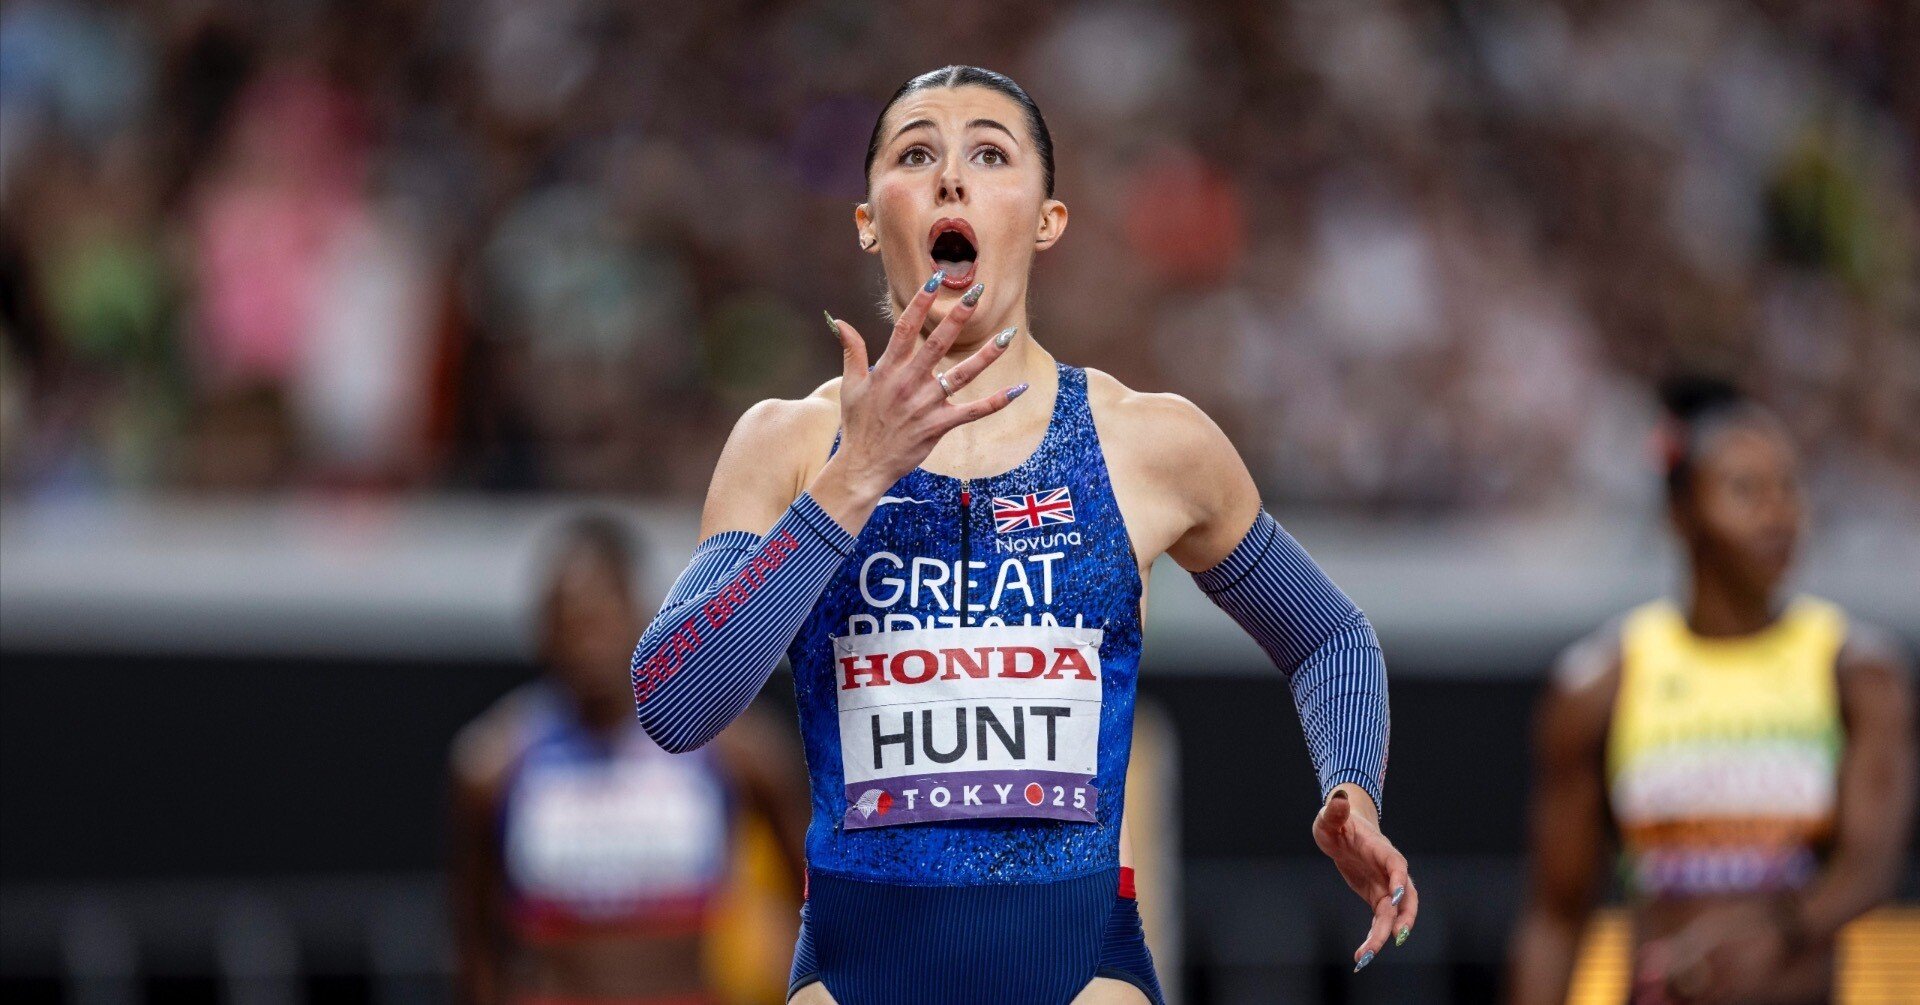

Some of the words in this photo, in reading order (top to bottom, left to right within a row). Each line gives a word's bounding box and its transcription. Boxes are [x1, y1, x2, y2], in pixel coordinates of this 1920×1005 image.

[996, 531, 1081, 553] Novuna
[704, 529, 800, 629] BRITAIN
[860, 552, 1064, 611] GREAT
[840, 647, 1097, 690] HONDA
[871, 706, 1071, 769] HUNT
